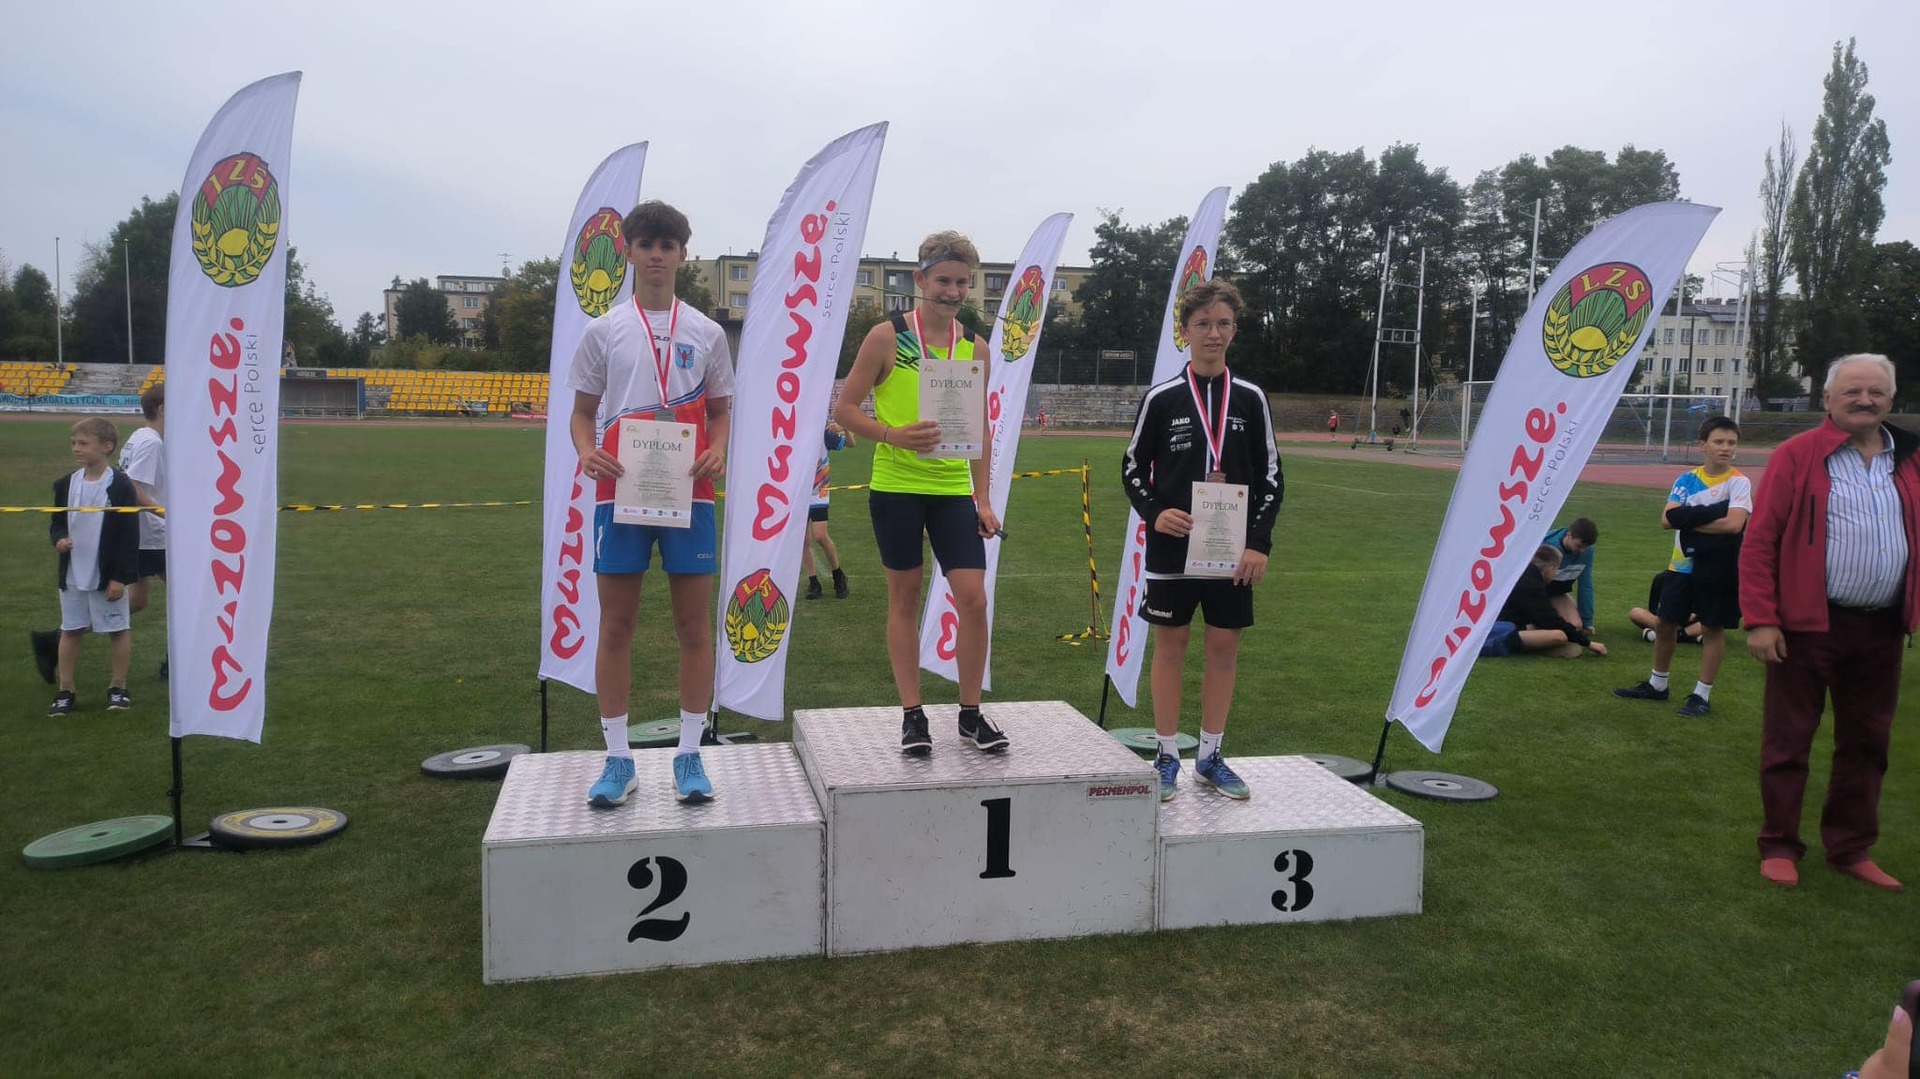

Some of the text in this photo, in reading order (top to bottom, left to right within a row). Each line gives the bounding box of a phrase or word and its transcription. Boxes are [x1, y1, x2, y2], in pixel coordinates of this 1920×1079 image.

[822, 211, 851, 319] serce Polski
[1580, 268, 1645, 301] LZS
[243, 333, 267, 455] serce Polski
[930, 378, 973, 389] DYPLOM
[632, 439, 682, 453] DYPLOM
[1171, 417, 1191, 426] JAKO
[1528, 418, 1579, 522] serce Polski
[1202, 500, 1239, 512] DYPLOM
[979, 798, 1017, 879] 1
[626, 855, 691, 943] 2
[1271, 849, 1314, 913] 3
